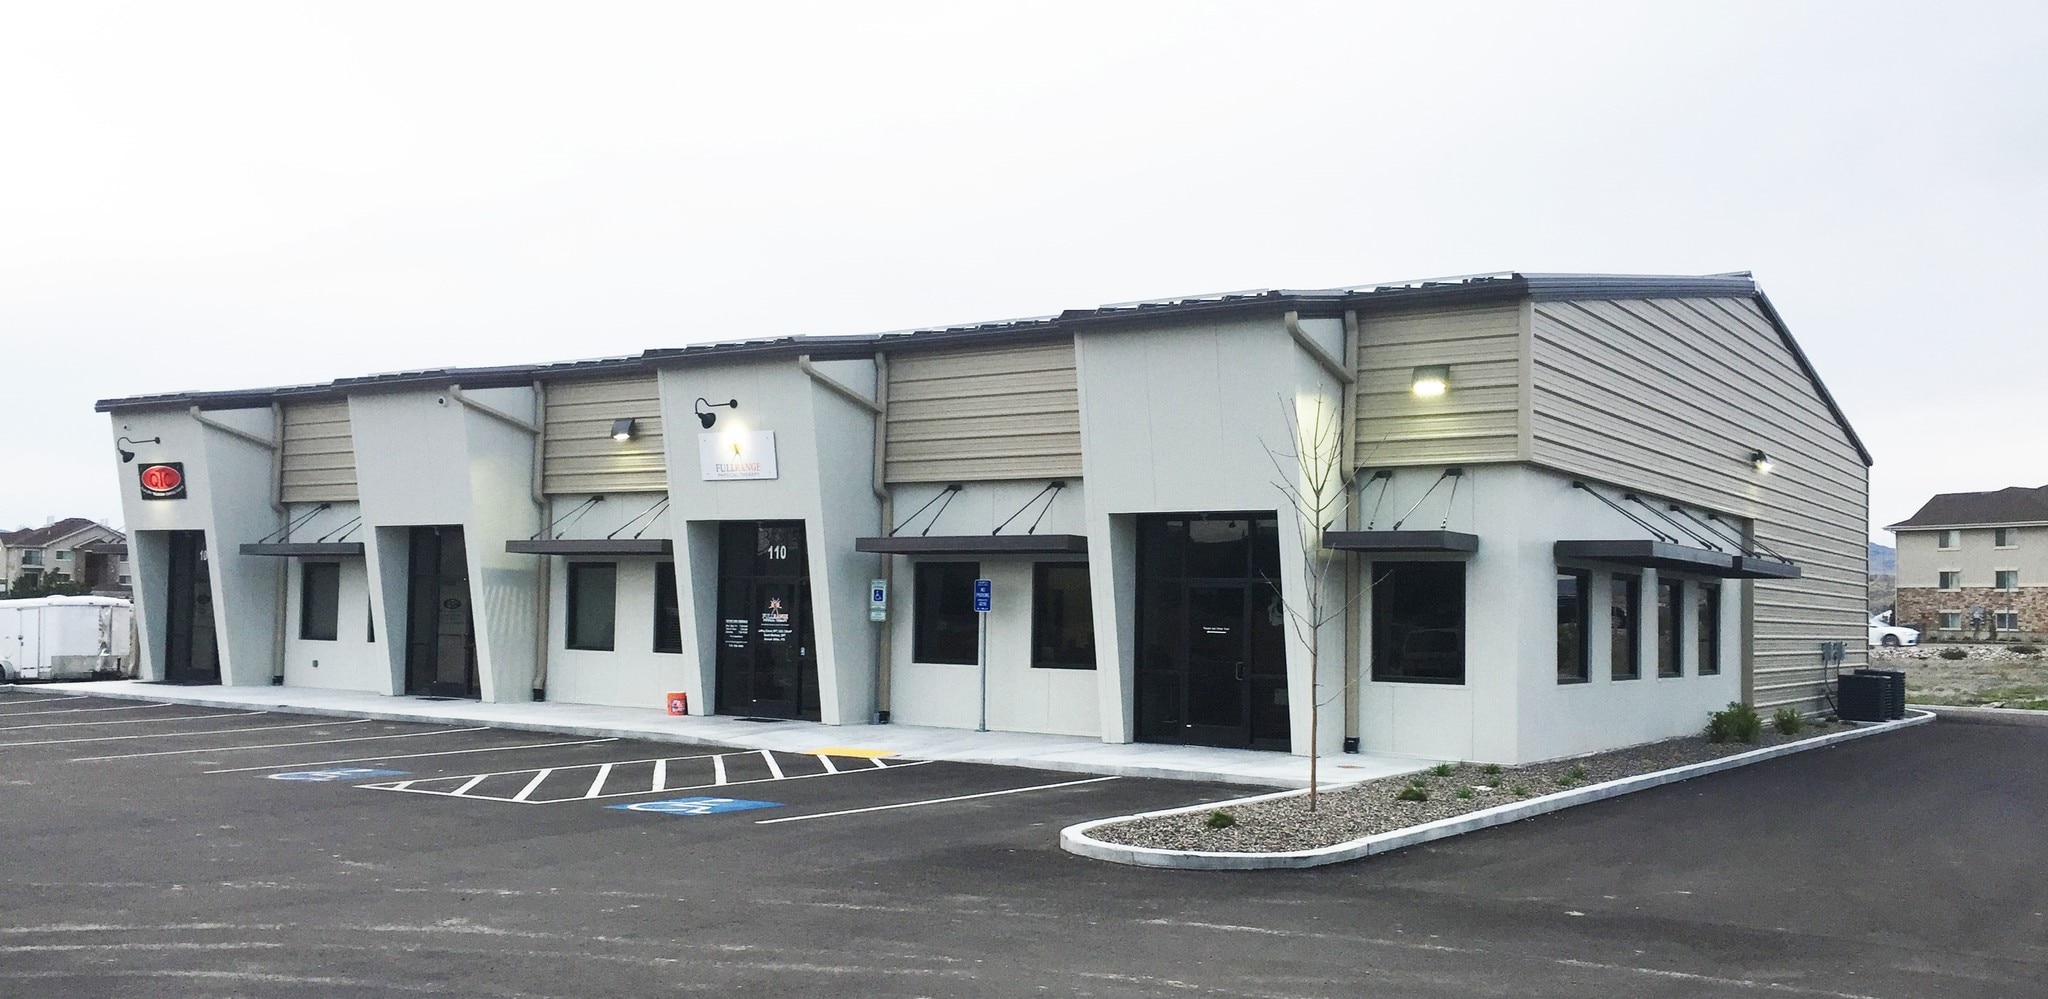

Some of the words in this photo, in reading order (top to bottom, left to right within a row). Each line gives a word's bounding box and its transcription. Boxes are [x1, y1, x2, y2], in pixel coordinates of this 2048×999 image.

[715, 462, 761, 473] FULLRANGE
[150, 470, 174, 488] QTC
[767, 545, 787, 560] 110
